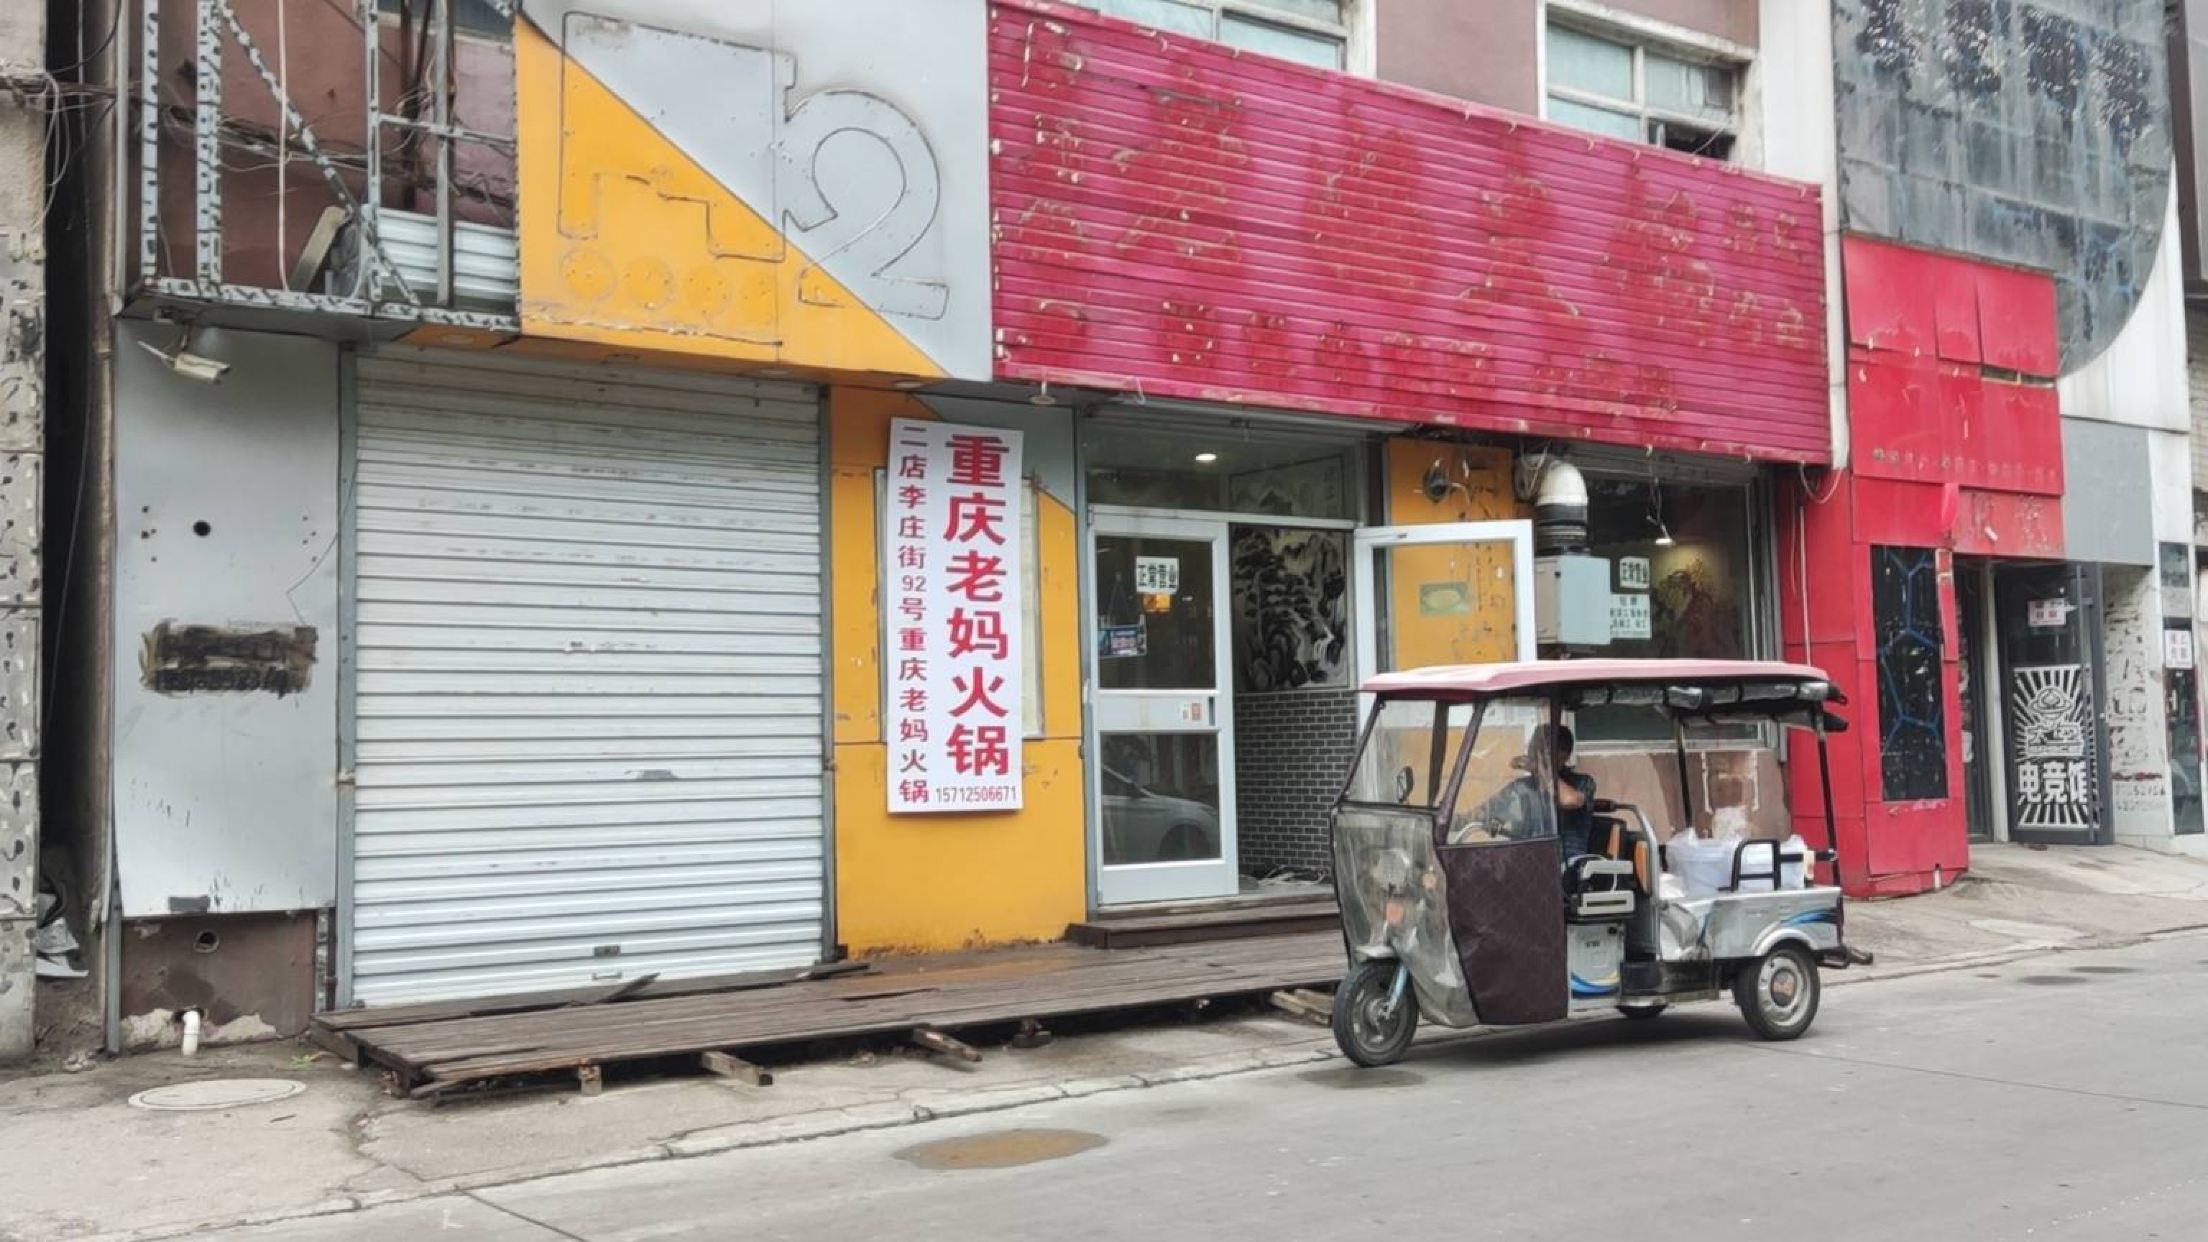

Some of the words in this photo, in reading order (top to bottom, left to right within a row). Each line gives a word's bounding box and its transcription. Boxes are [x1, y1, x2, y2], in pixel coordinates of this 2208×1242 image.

[898, 426, 929, 803] 二店李庄街92号重庆老妈火锅
[943, 434, 1009, 776] 重庆老妈火锅
[936, 787, 1017, 803] 15712506671
